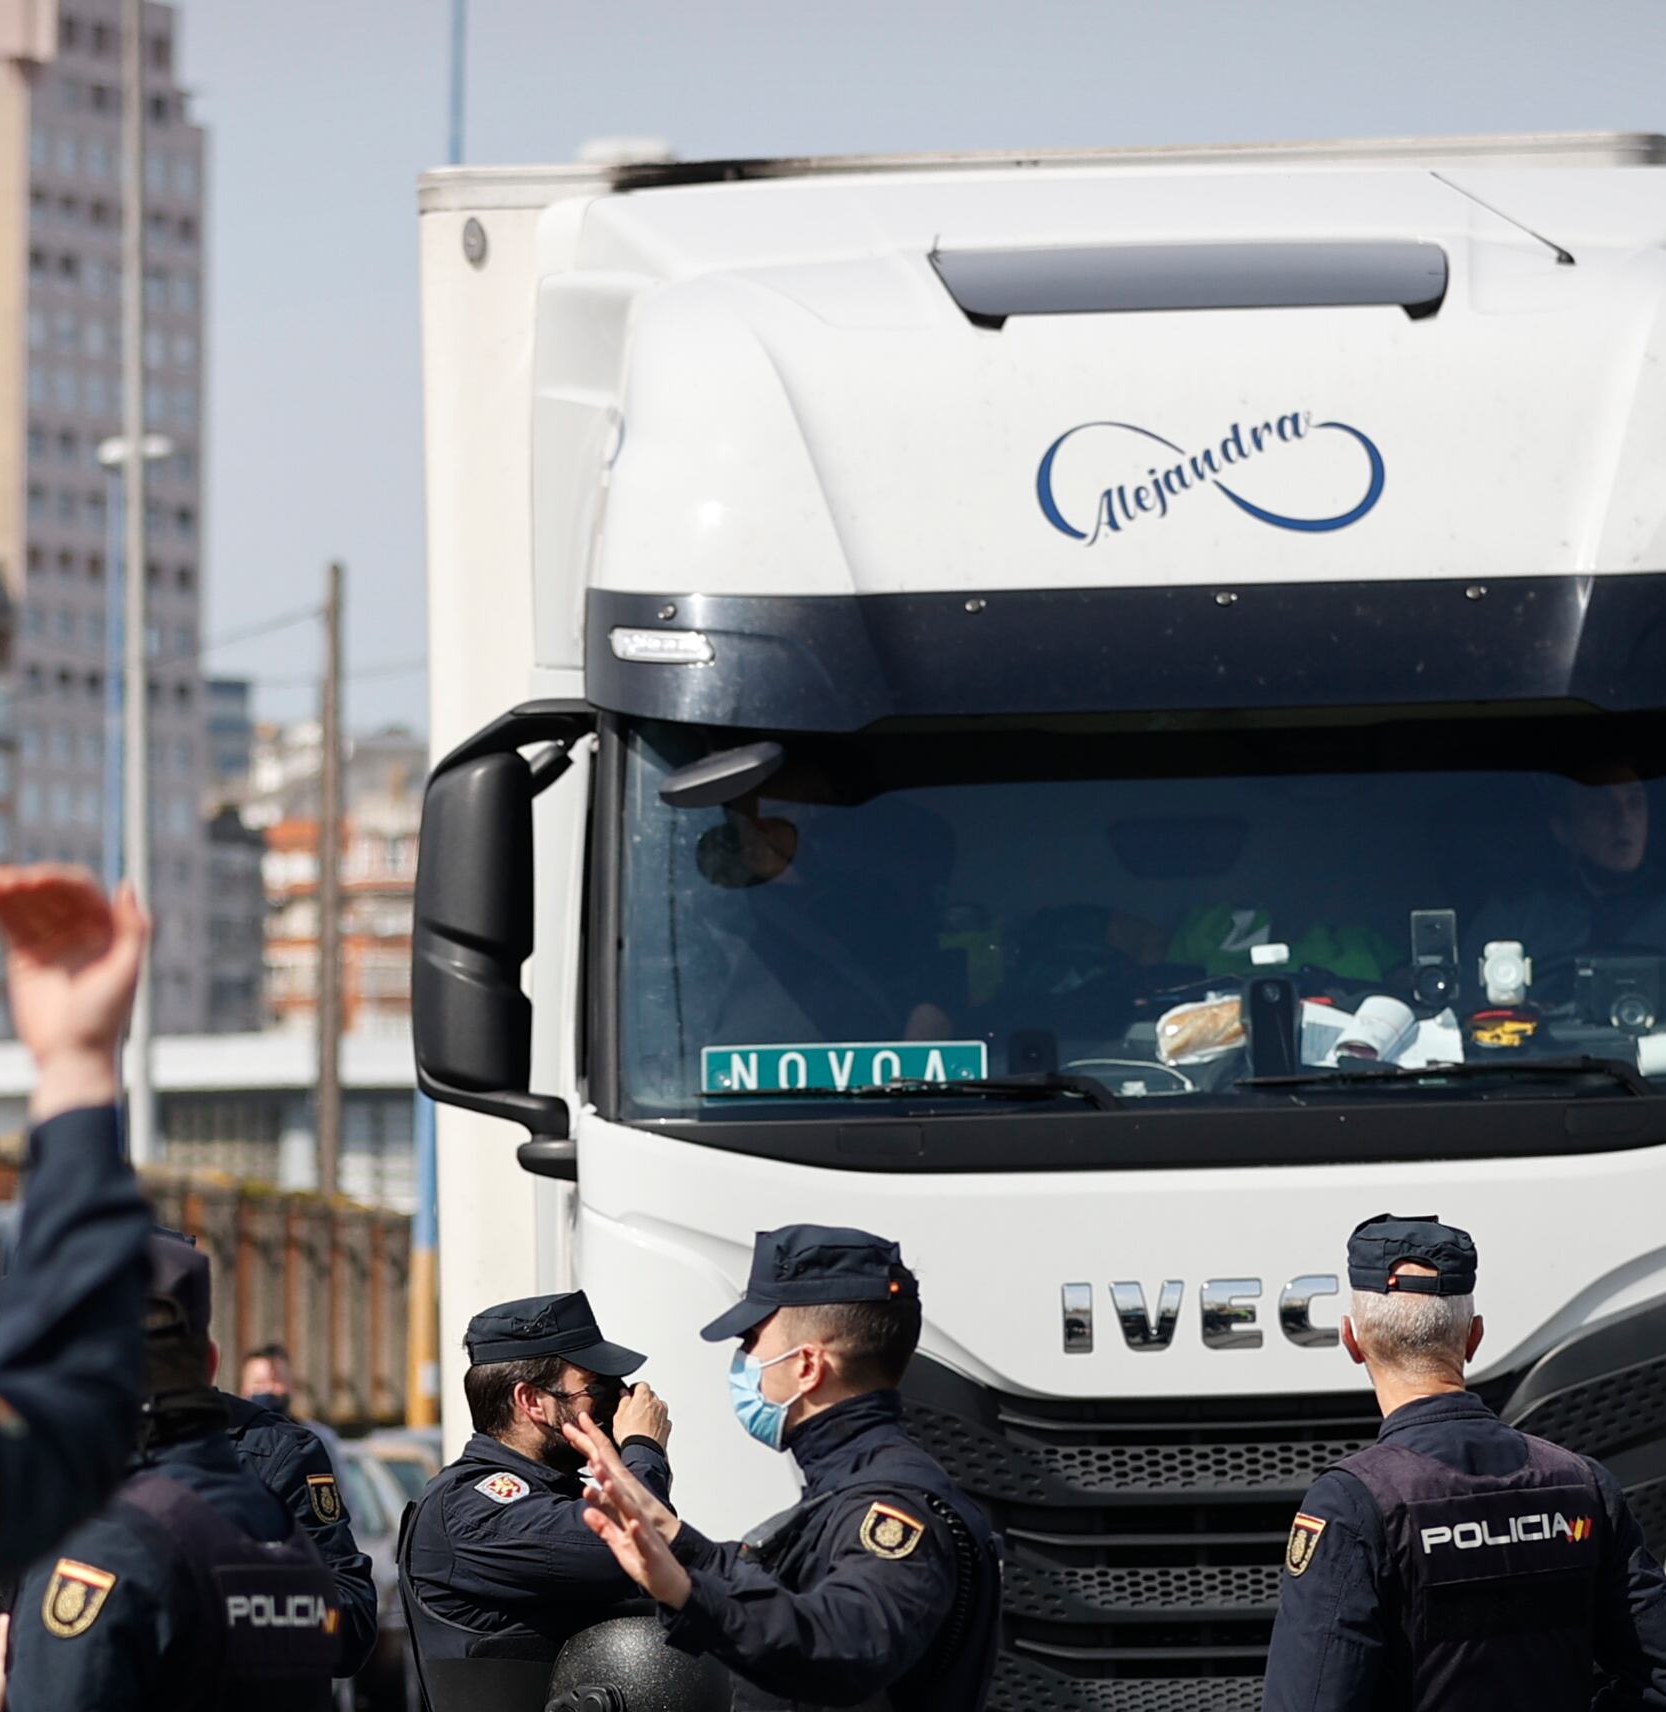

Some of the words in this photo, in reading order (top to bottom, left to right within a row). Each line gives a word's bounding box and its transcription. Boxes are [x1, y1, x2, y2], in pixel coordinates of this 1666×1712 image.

[1085, 410, 1313, 547] Alejandra
[731, 1049, 947, 1092] NOVOA
[1420, 1512, 1573, 1555] POLICIA
[227, 1593, 328, 1629] POLICIA
